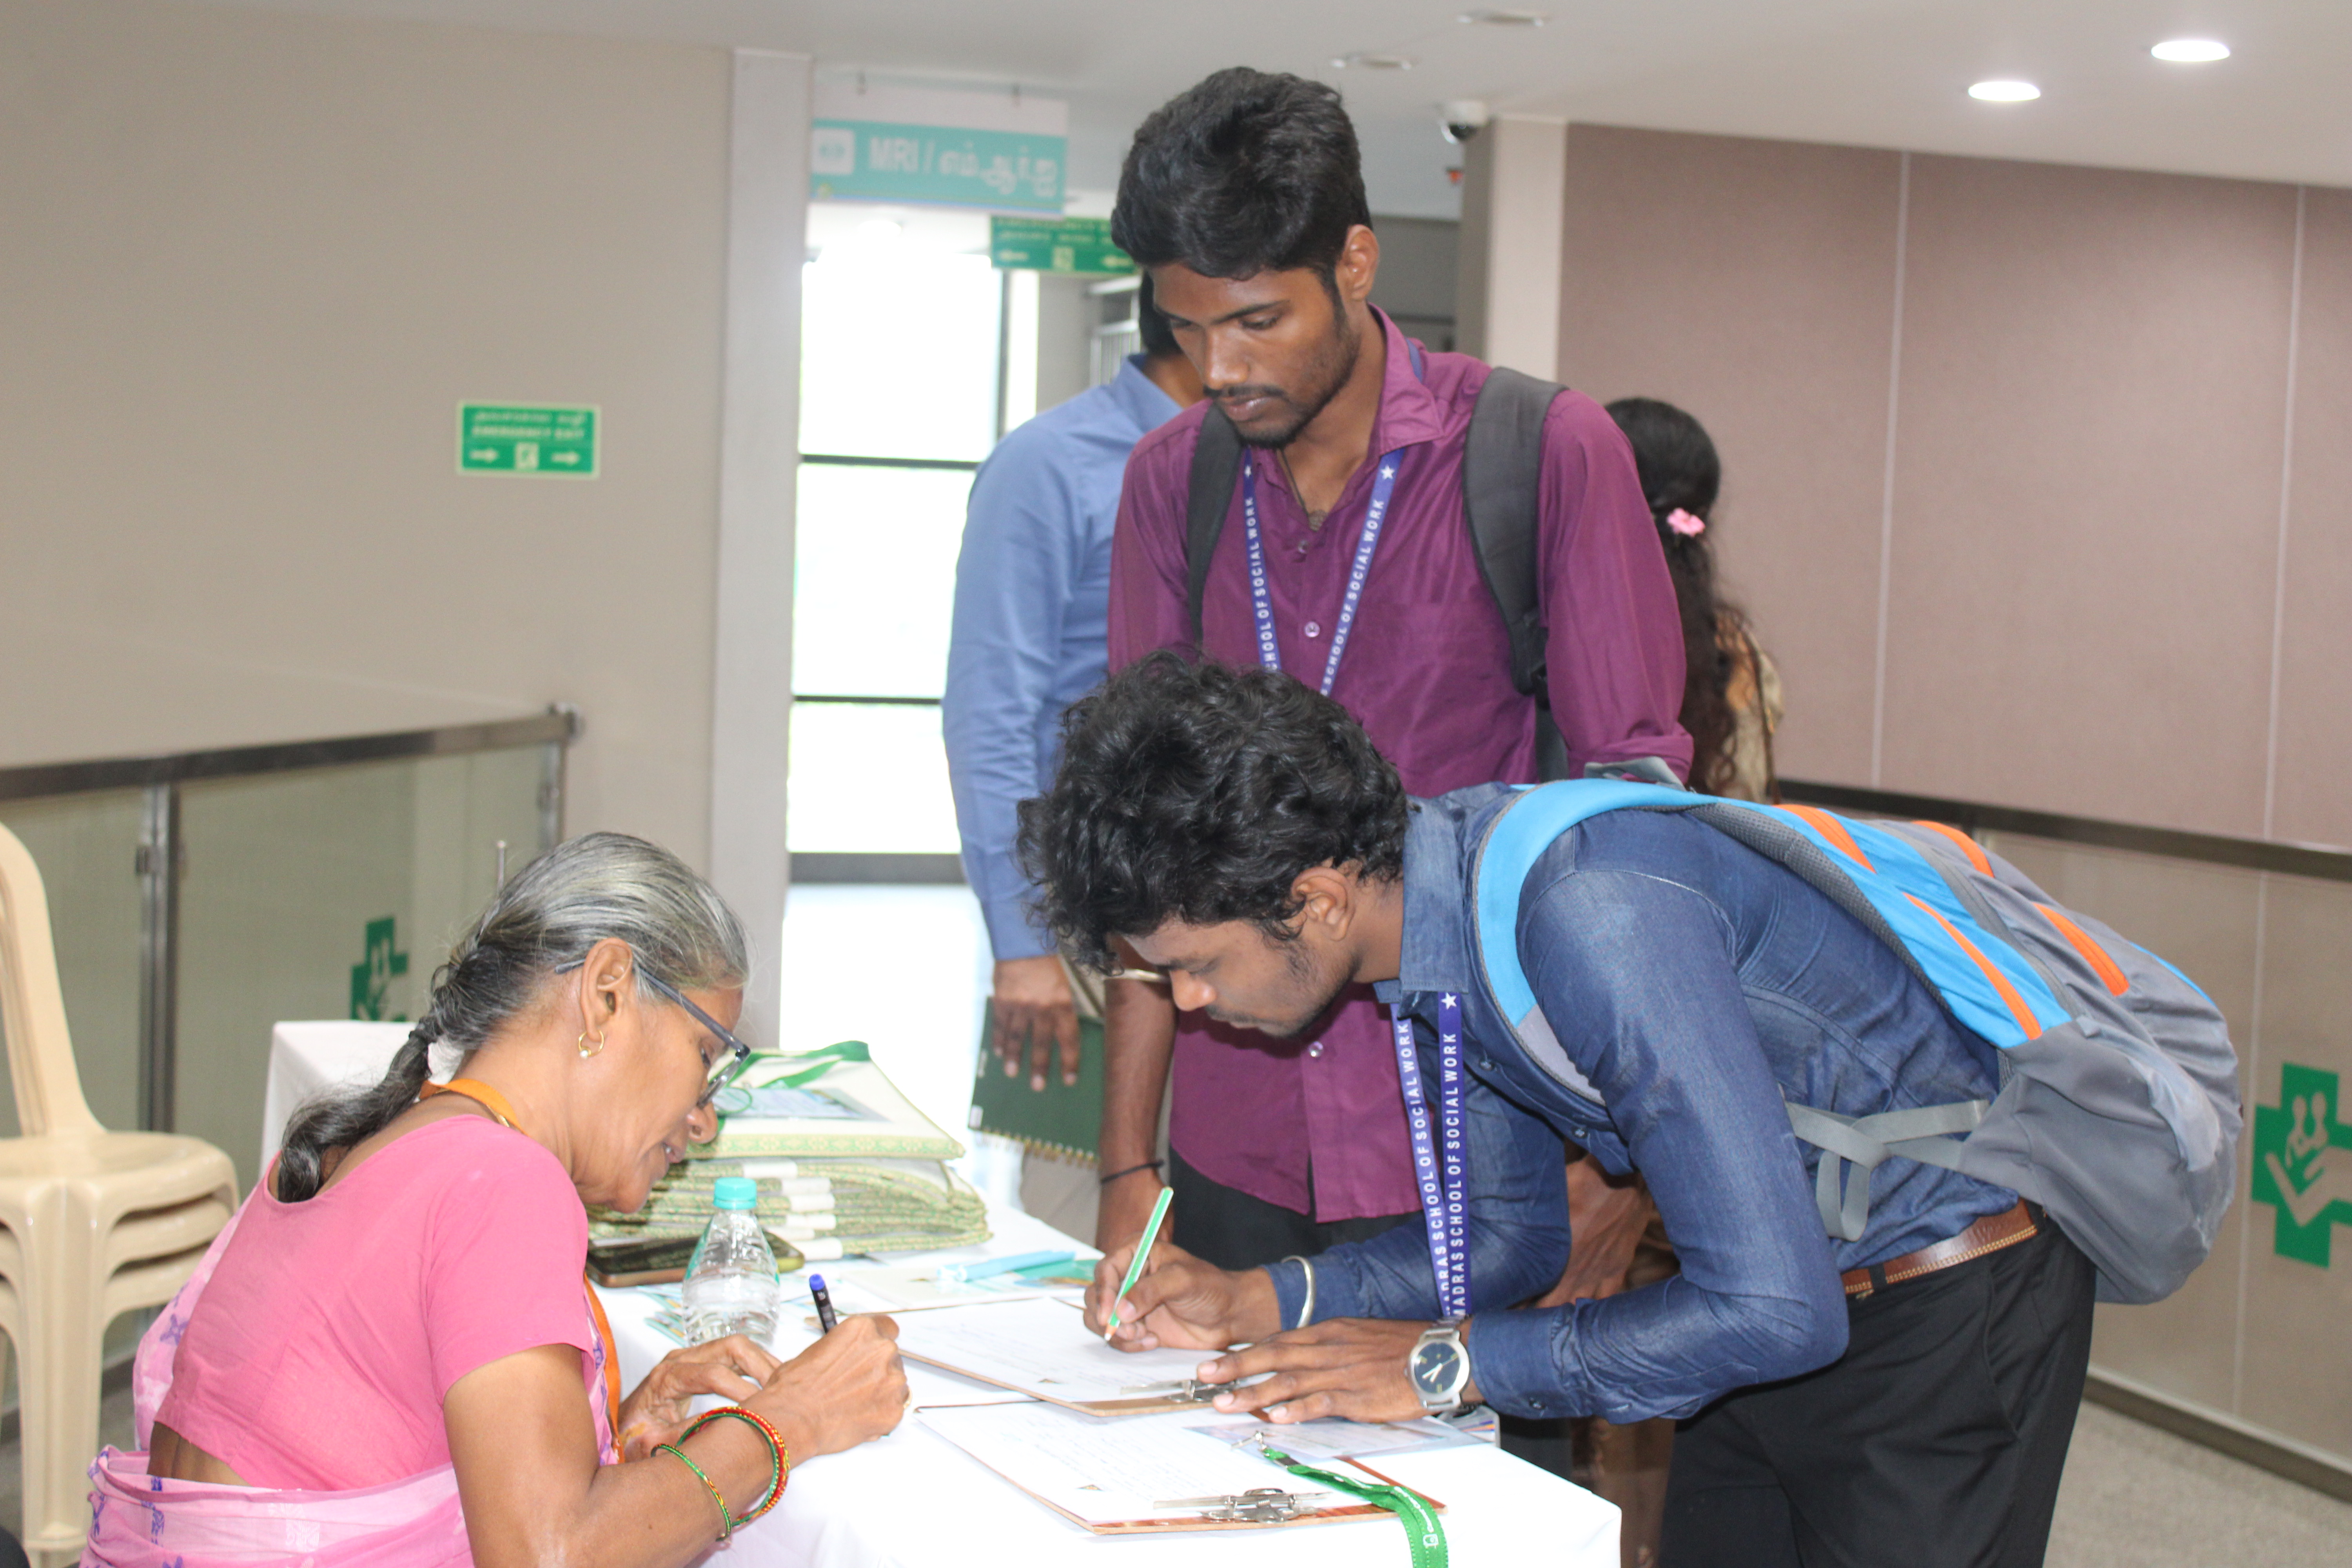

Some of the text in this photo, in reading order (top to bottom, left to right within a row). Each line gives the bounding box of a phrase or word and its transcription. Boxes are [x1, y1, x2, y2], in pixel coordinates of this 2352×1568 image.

[869, 137, 918, 172] MRI
[1244, 497, 1258, 540] WORK
[1249, 541, 1266, 597] SOCIAL
[1323, 499, 1385, 685] SCHOOL OF SOCIAL WORK
[1256, 601, 1270, 619] OF
[1397, 1023, 1415, 1073] WORK
[1443, 1033, 1457, 1082] WORK
[1406, 1077, 1427, 1141] SOCIAL
[1445, 1087, 1460, 1149] SOCIAL
[1417, 1146, 1432, 1167] OF
[1447, 1154, 1461, 1175] OF
[1422, 1171, 1445, 1241] SCHOOL
[1448, 1180, 1464, 1247] SCHOOL
